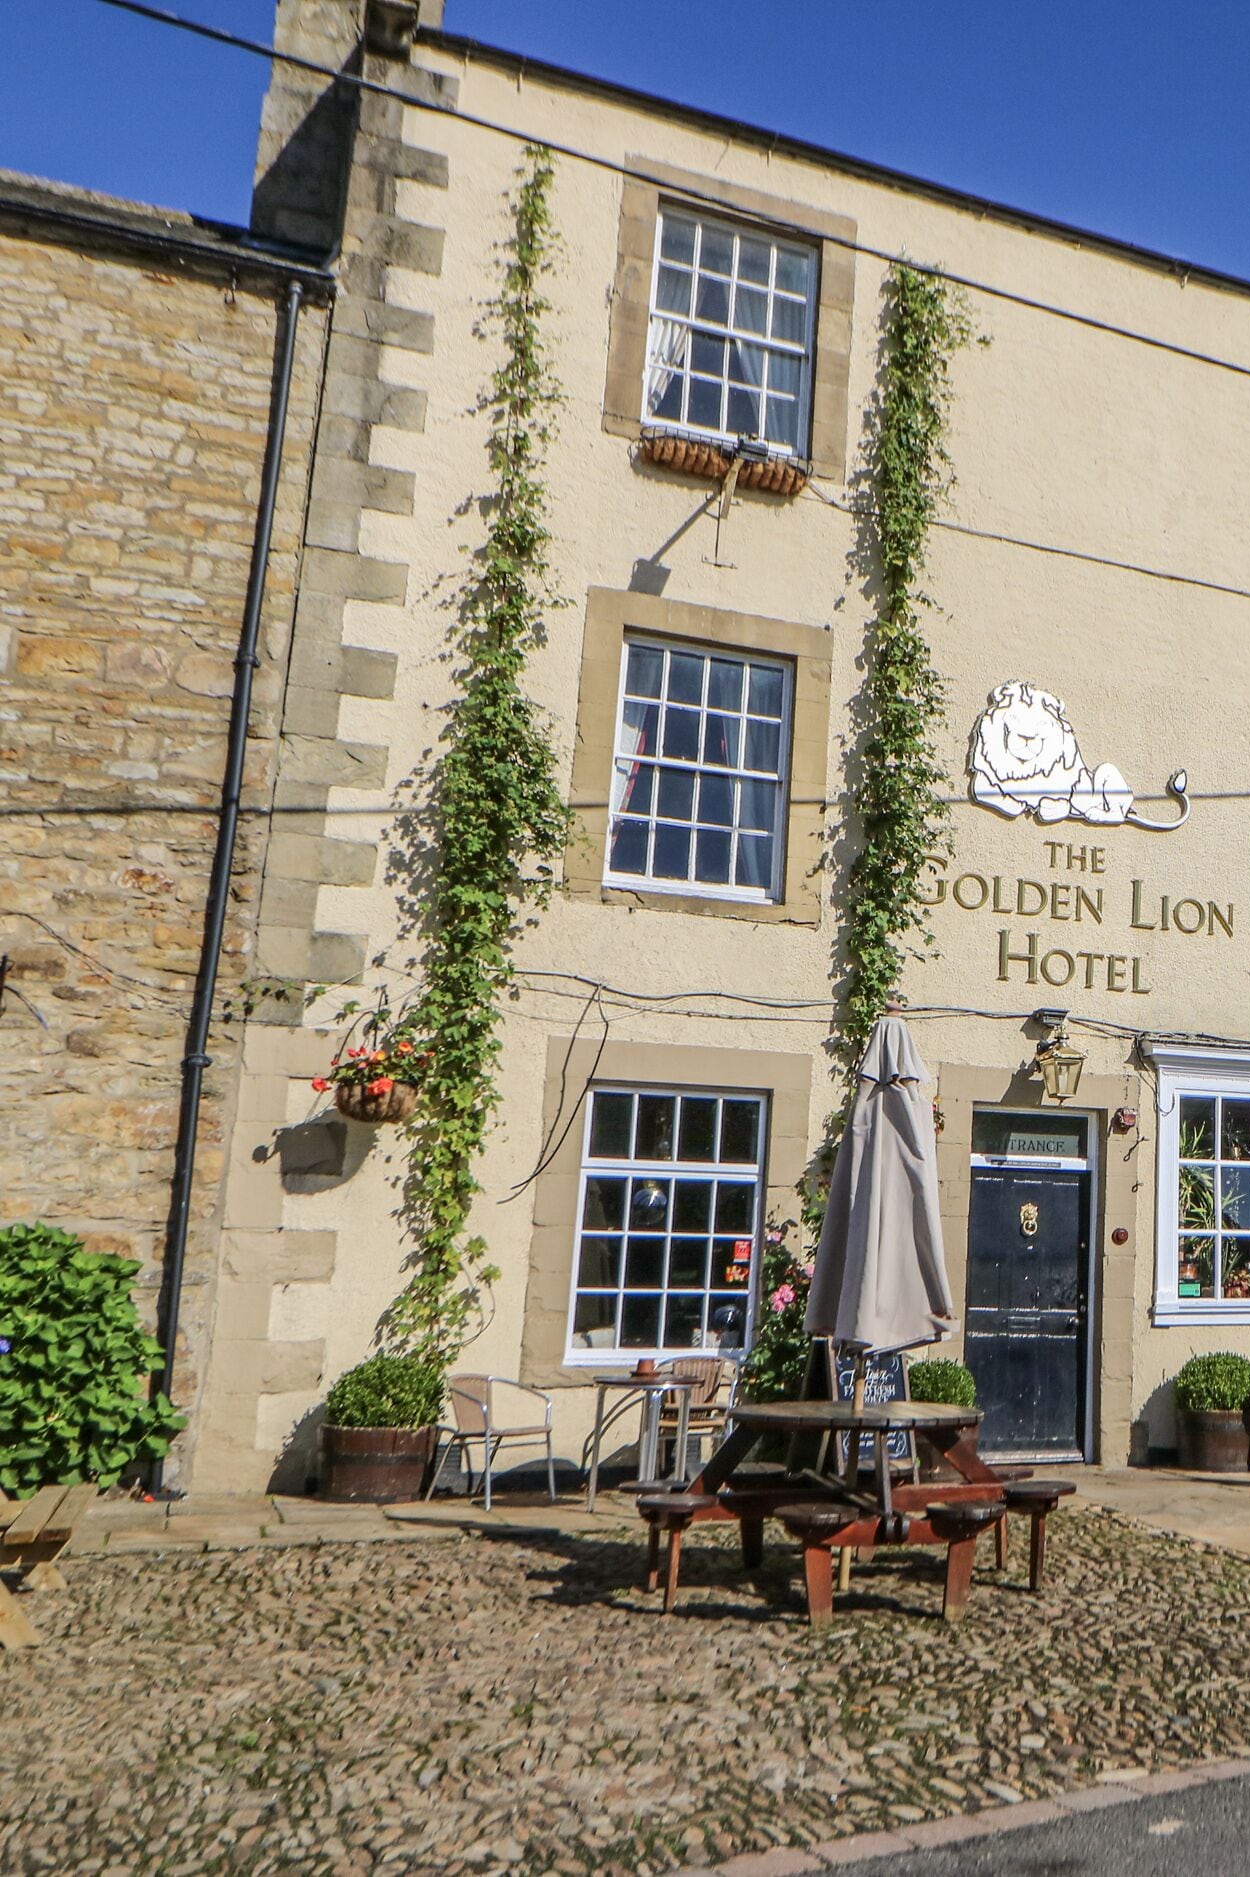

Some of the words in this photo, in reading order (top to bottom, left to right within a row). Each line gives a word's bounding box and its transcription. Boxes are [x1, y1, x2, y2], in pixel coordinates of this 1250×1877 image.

[1043, 840, 1106, 873] THE
[915, 853, 1104, 926] GOLDEN
[1128, 878, 1234, 938] LION
[995, 928, 1153, 994] HOTEL
[1008, 1139, 1066, 1153] TRANCE
